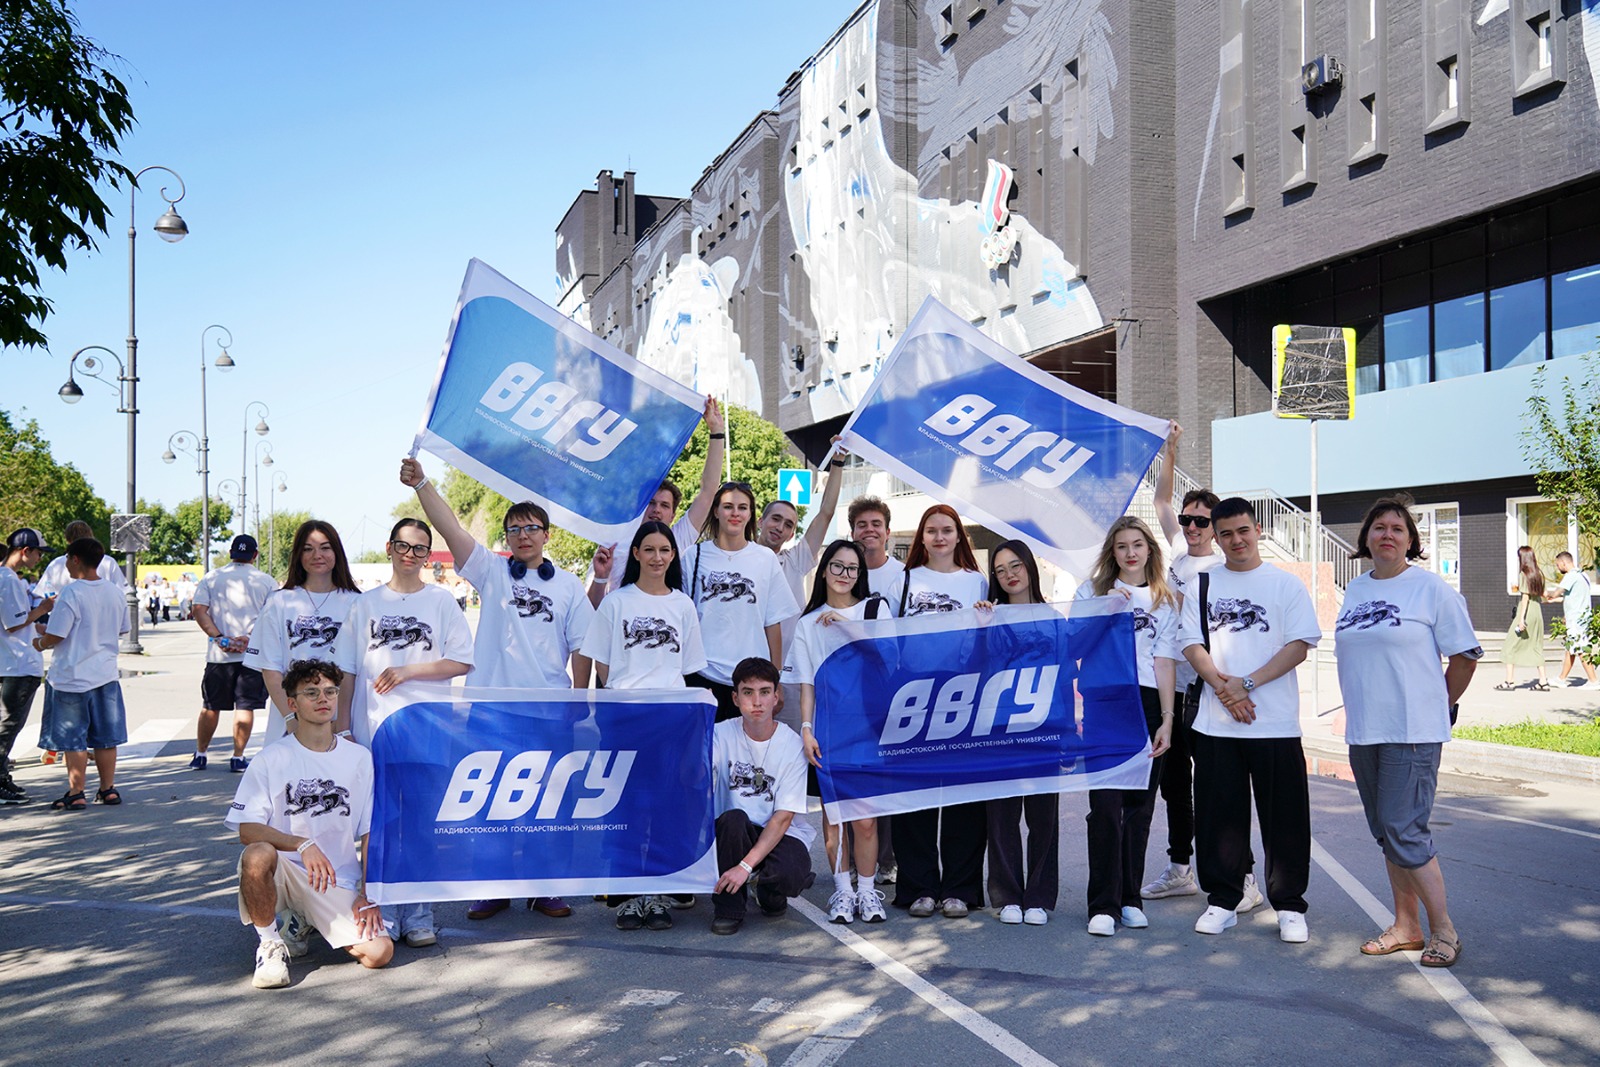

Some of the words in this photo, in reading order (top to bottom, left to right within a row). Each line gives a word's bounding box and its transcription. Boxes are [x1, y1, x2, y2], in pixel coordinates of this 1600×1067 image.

[479, 361, 638, 462] ВВГУ
[923, 394, 1096, 489] ВВГУ
[569, 461, 605, 482] УНИВЕРСИТЕТ
[878, 664, 1060, 746] ВВГУ
[878, 743, 947, 757] ВЛАДИВОСТОКСКИЙ
[948, 738, 1014, 750] ГОСУДАРСТВЕННЫЙ
[1016, 734, 1061, 743] УНИВЕРСИТЕТ
[435, 750, 638, 822] ВВГУ
[434, 825, 508, 834] ВЛАДИВОСТОКСКИЙ
[510, 823, 579, 833] ГОСУДАРСТВЕННЫЙ
[581, 823, 628, 832] УНИВЕРСИТЕТ
